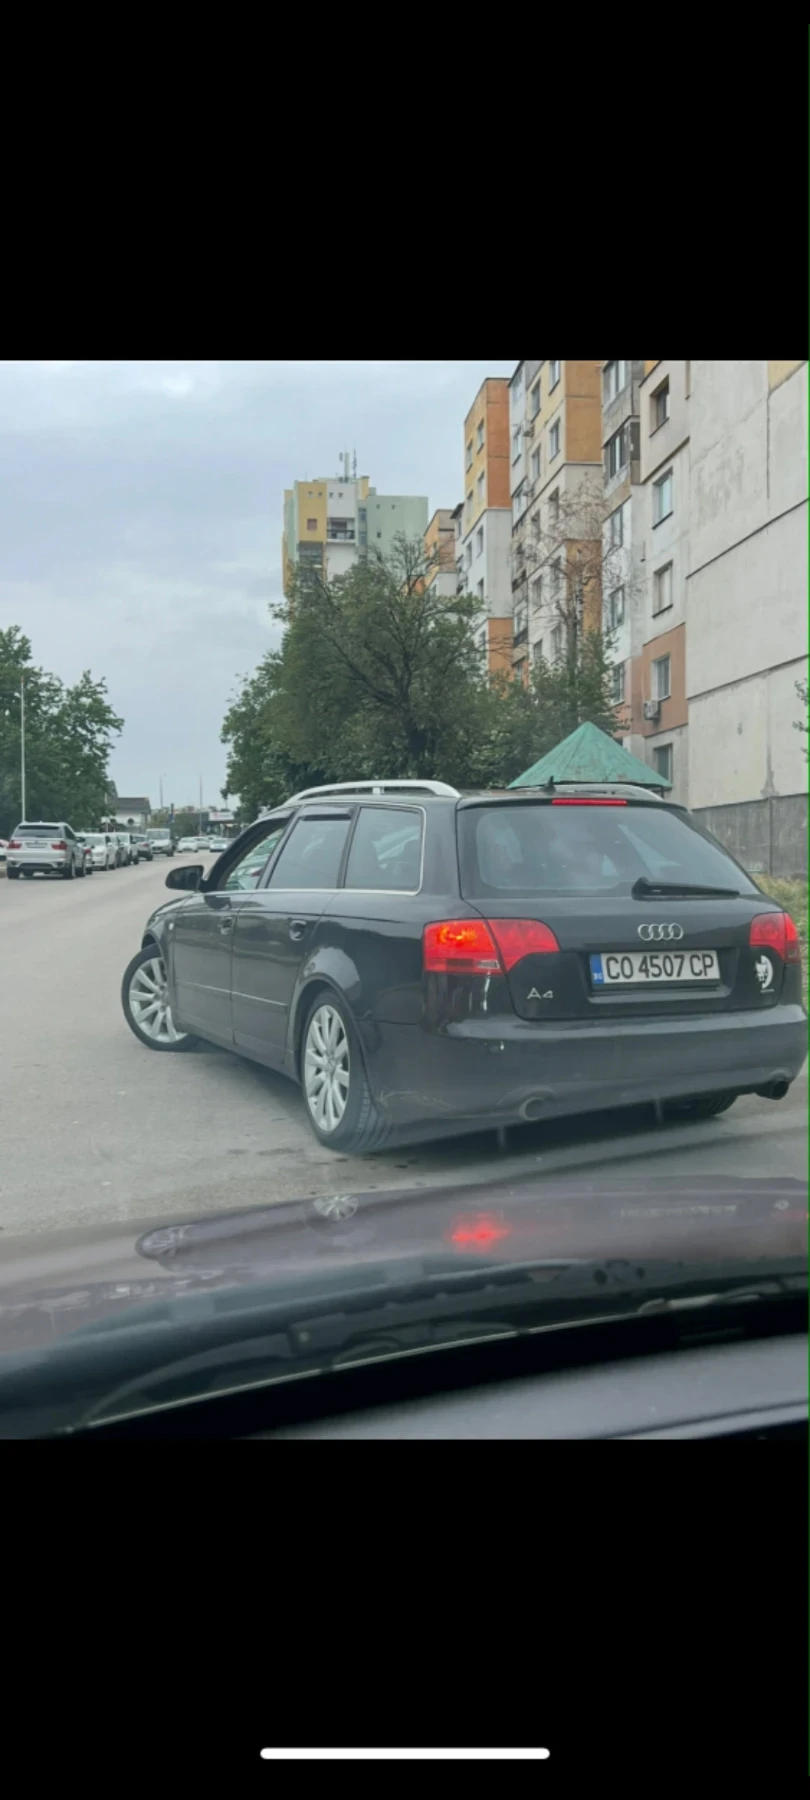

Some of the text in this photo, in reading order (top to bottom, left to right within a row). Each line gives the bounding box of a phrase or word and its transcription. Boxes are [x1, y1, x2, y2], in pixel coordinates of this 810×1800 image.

[605, 953, 715, 980] CO 4507 CP
[526, 987, 554, 1000] A4
